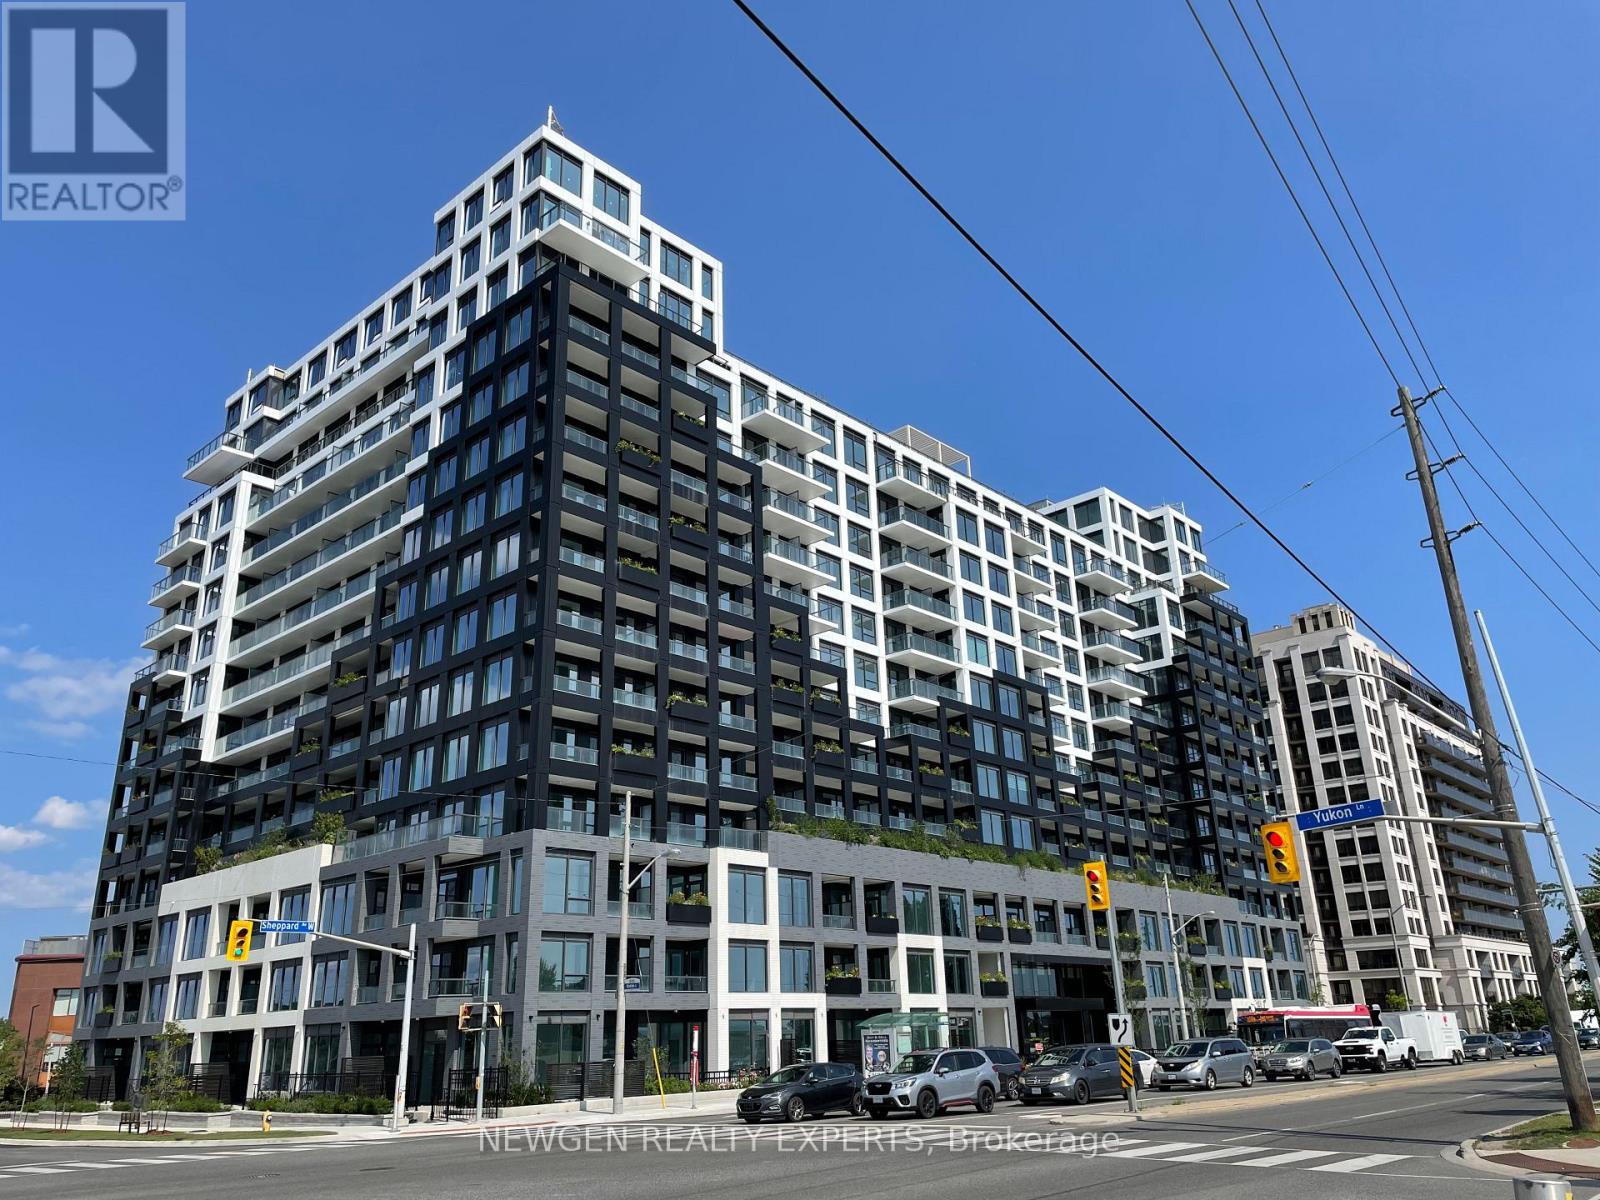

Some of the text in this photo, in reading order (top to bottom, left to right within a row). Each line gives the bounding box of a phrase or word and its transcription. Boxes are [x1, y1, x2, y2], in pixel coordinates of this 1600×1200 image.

[1313, 803, 1364, 823] Yukon Ln
[262, 921, 298, 930] Sheppard
[308, 922, 315, 930] W
